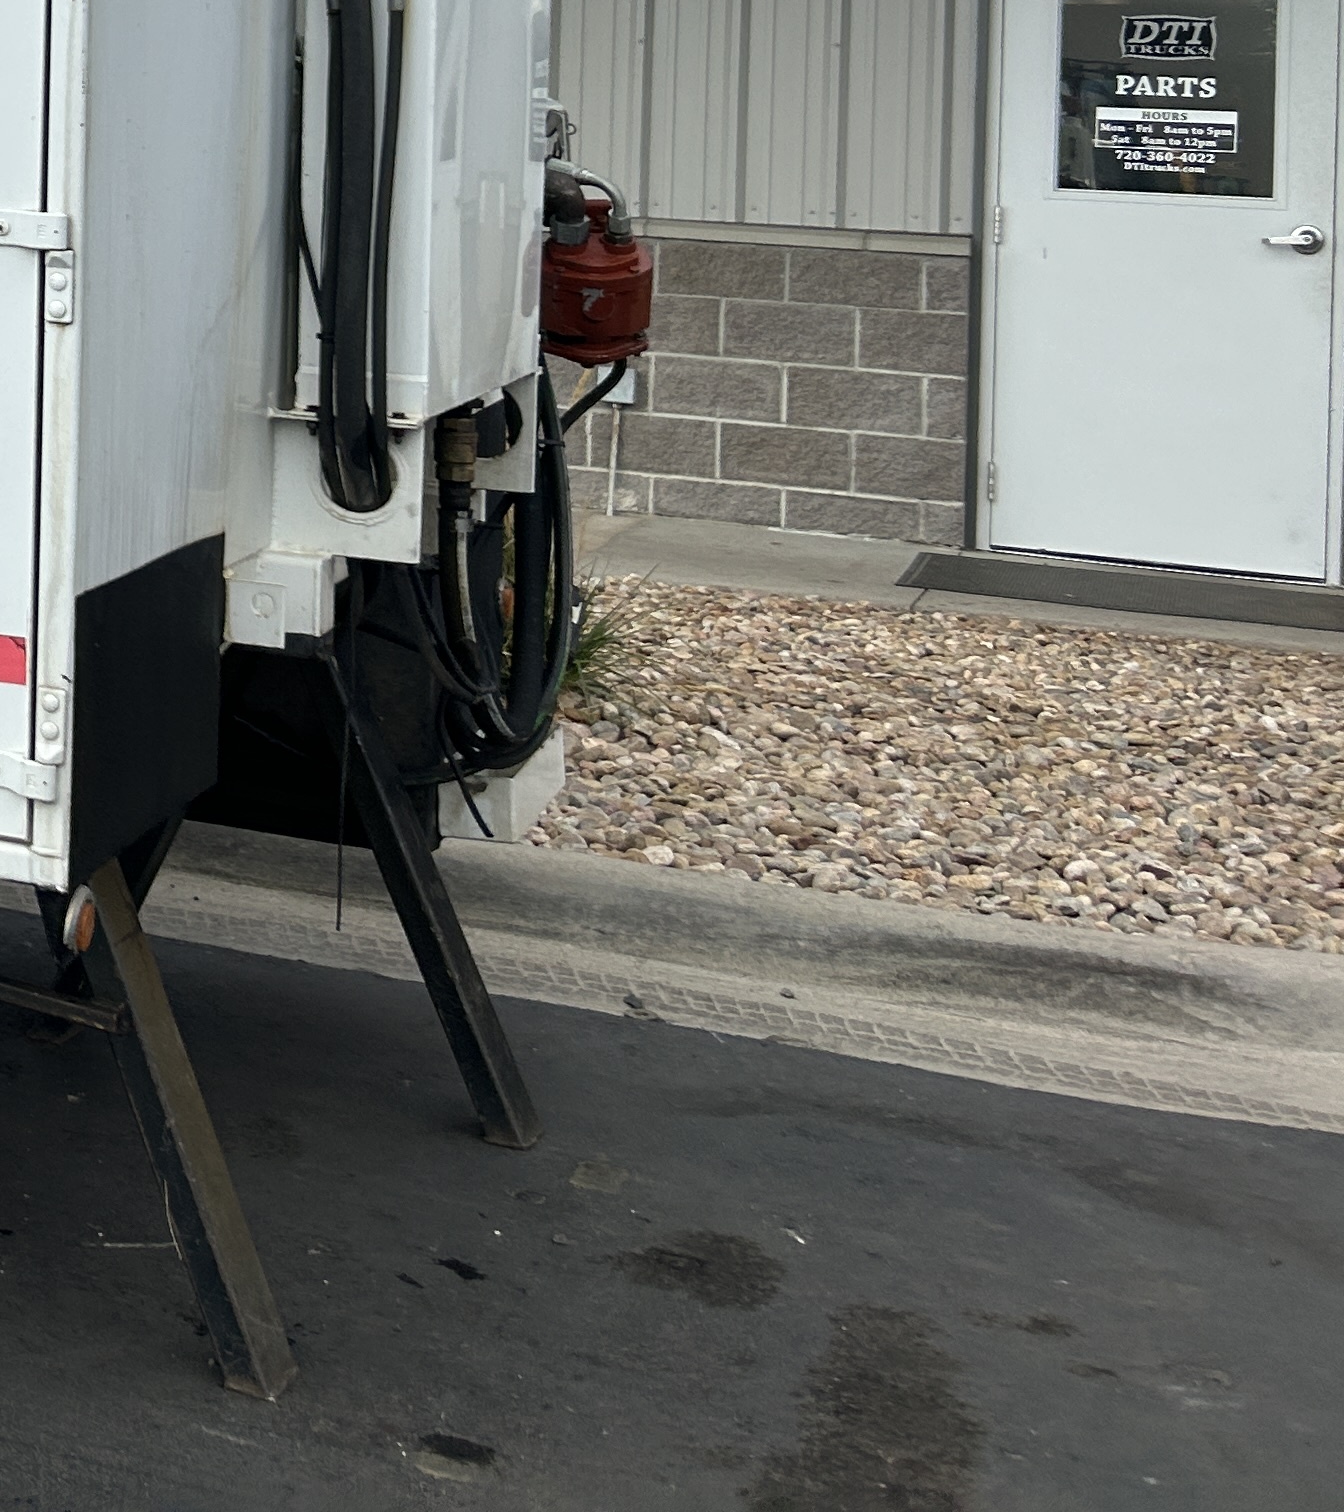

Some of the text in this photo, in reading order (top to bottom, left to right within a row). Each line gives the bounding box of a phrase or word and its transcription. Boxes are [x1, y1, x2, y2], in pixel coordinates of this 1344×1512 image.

[1127, 20, 1209, 45] DTI
[1125, 44, 1210, 56] TRUCKS
[1115, 74, 1217, 98] PARTS
[1141, 111, 1188, 121] HOURS
[1099, 122, 1125, 132] Mon
[1135, 124, 1153, 133] Fri
[1163, 125, 1189, 134] 8am
[1191, 127, 1205, 135] to
[1206, 126, 1233, 138] 5pm
[1111, 134, 1217, 148] Sat 8am to 12pm
[1114, 149, 1216, 164] 720-360-4022
